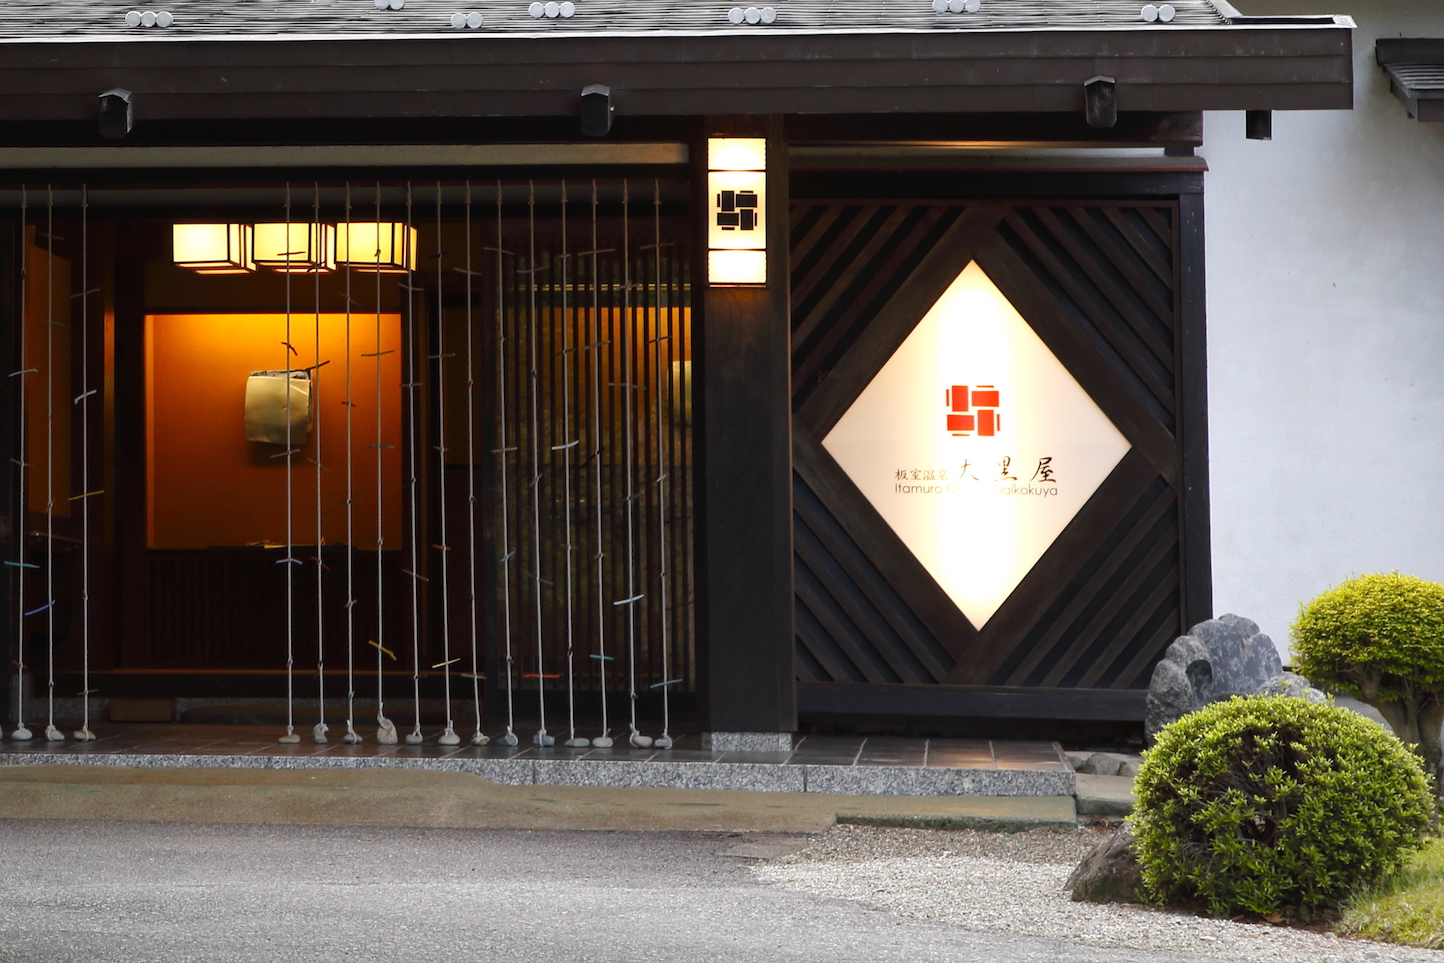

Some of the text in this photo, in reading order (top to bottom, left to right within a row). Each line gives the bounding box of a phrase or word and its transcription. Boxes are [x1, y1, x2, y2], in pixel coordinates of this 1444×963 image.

[894, 468, 949, 481] 板室温泉
[894, 483, 943, 494] Itamuro
[993, 483, 1058, 498] Daikokuya
